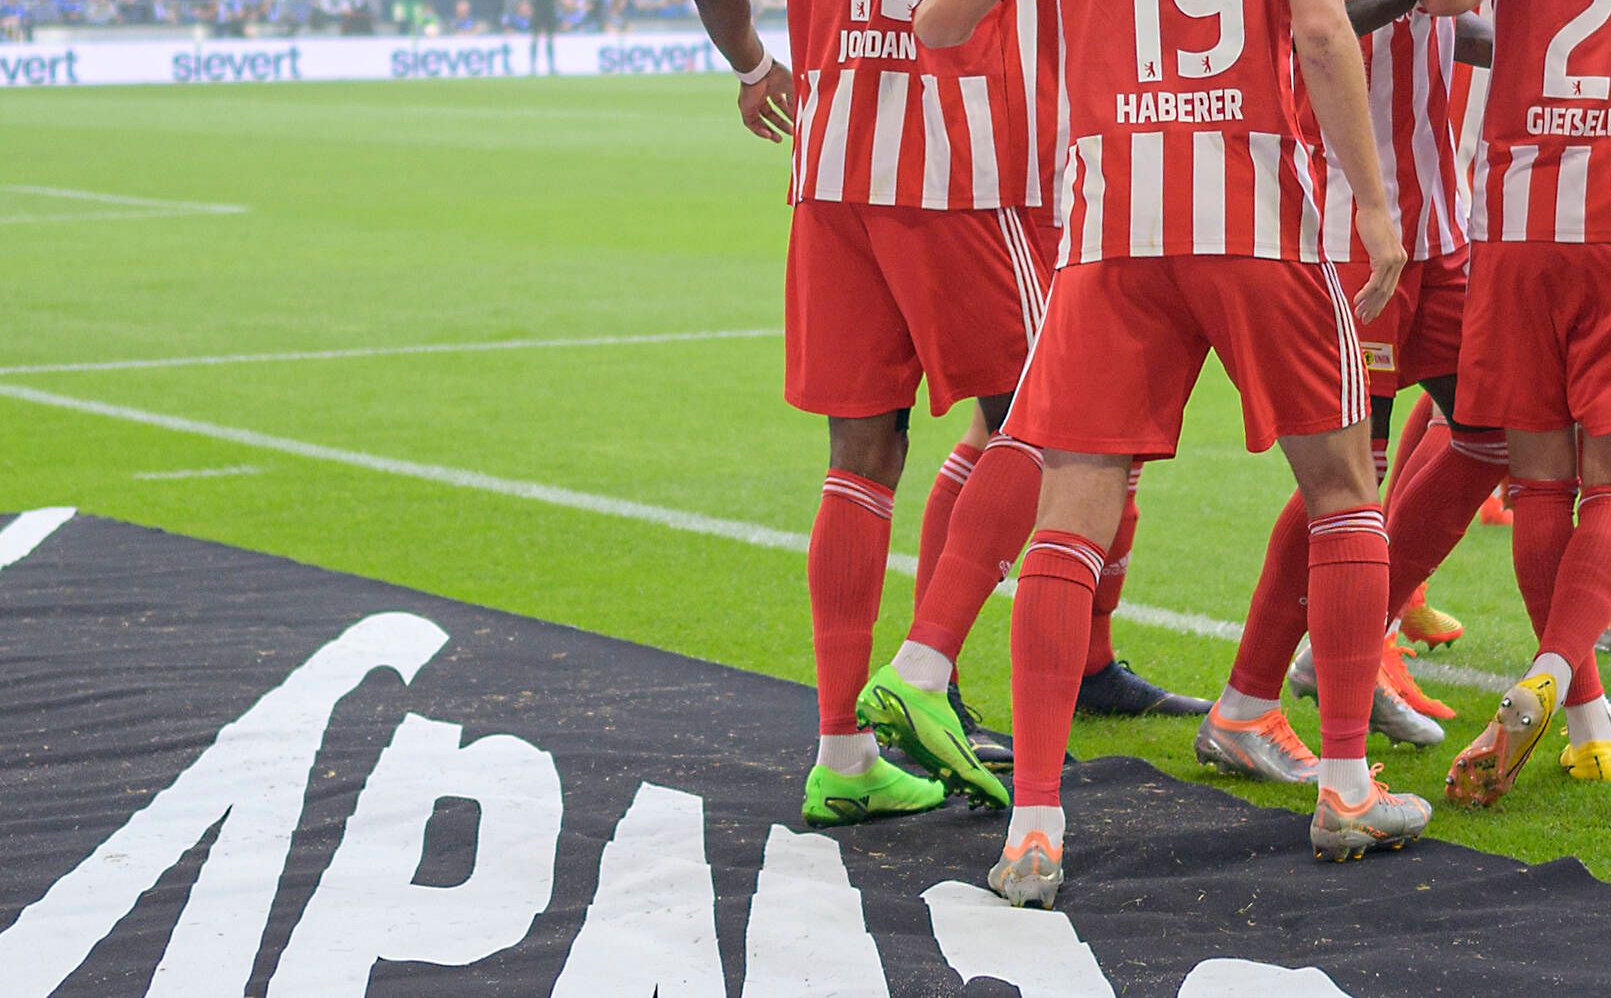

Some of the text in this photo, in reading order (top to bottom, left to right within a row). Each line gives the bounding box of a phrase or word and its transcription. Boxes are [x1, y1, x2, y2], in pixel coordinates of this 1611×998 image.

[172, 45, 303, 82] sievert
[391, 41, 514, 76] sievert
[597, 40, 716, 73] sievert
[838, 30, 917, 63] JODAN
[0, 49, 78, 85] vert
[1116, 88, 1243, 124] HABERER
